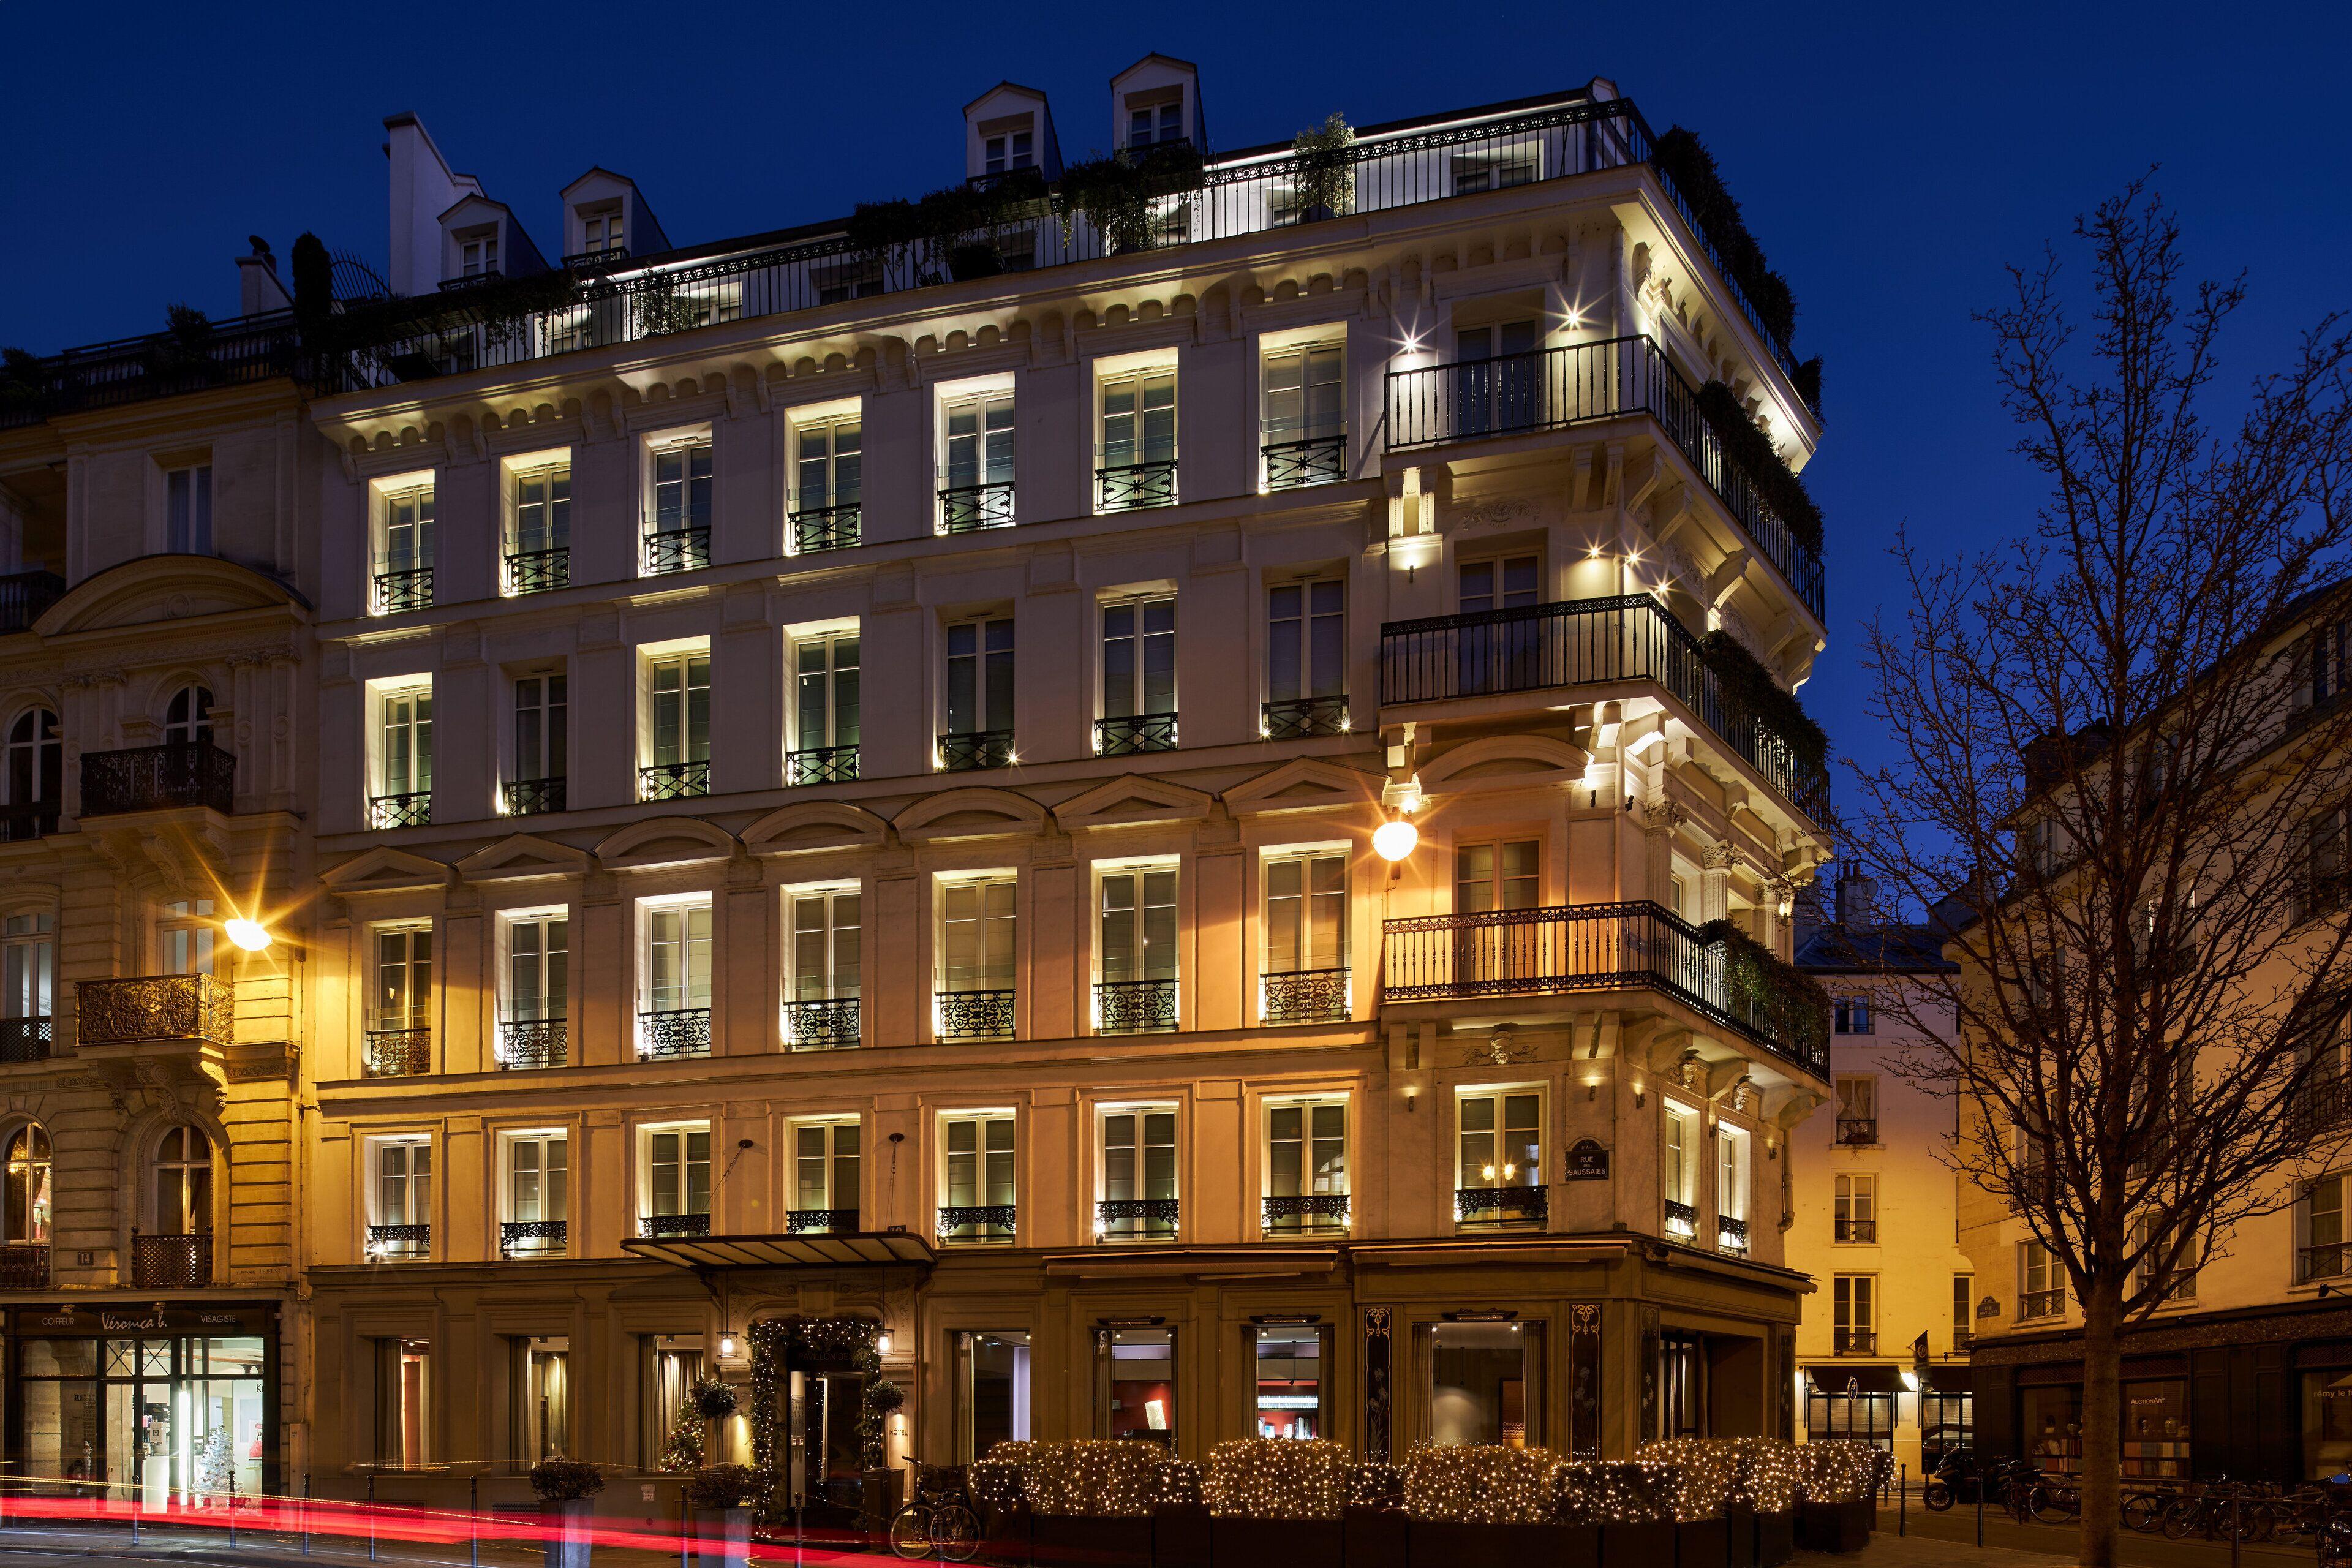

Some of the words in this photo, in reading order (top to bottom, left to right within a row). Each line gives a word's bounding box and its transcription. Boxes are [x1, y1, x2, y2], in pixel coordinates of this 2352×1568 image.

[81, 1254, 89, 1263] 14
[102, 1312, 154, 1330] Véronica
[200, 1314, 236, 1323] VISAGISTE
[2313, 1390, 2335, 1398] rémy
